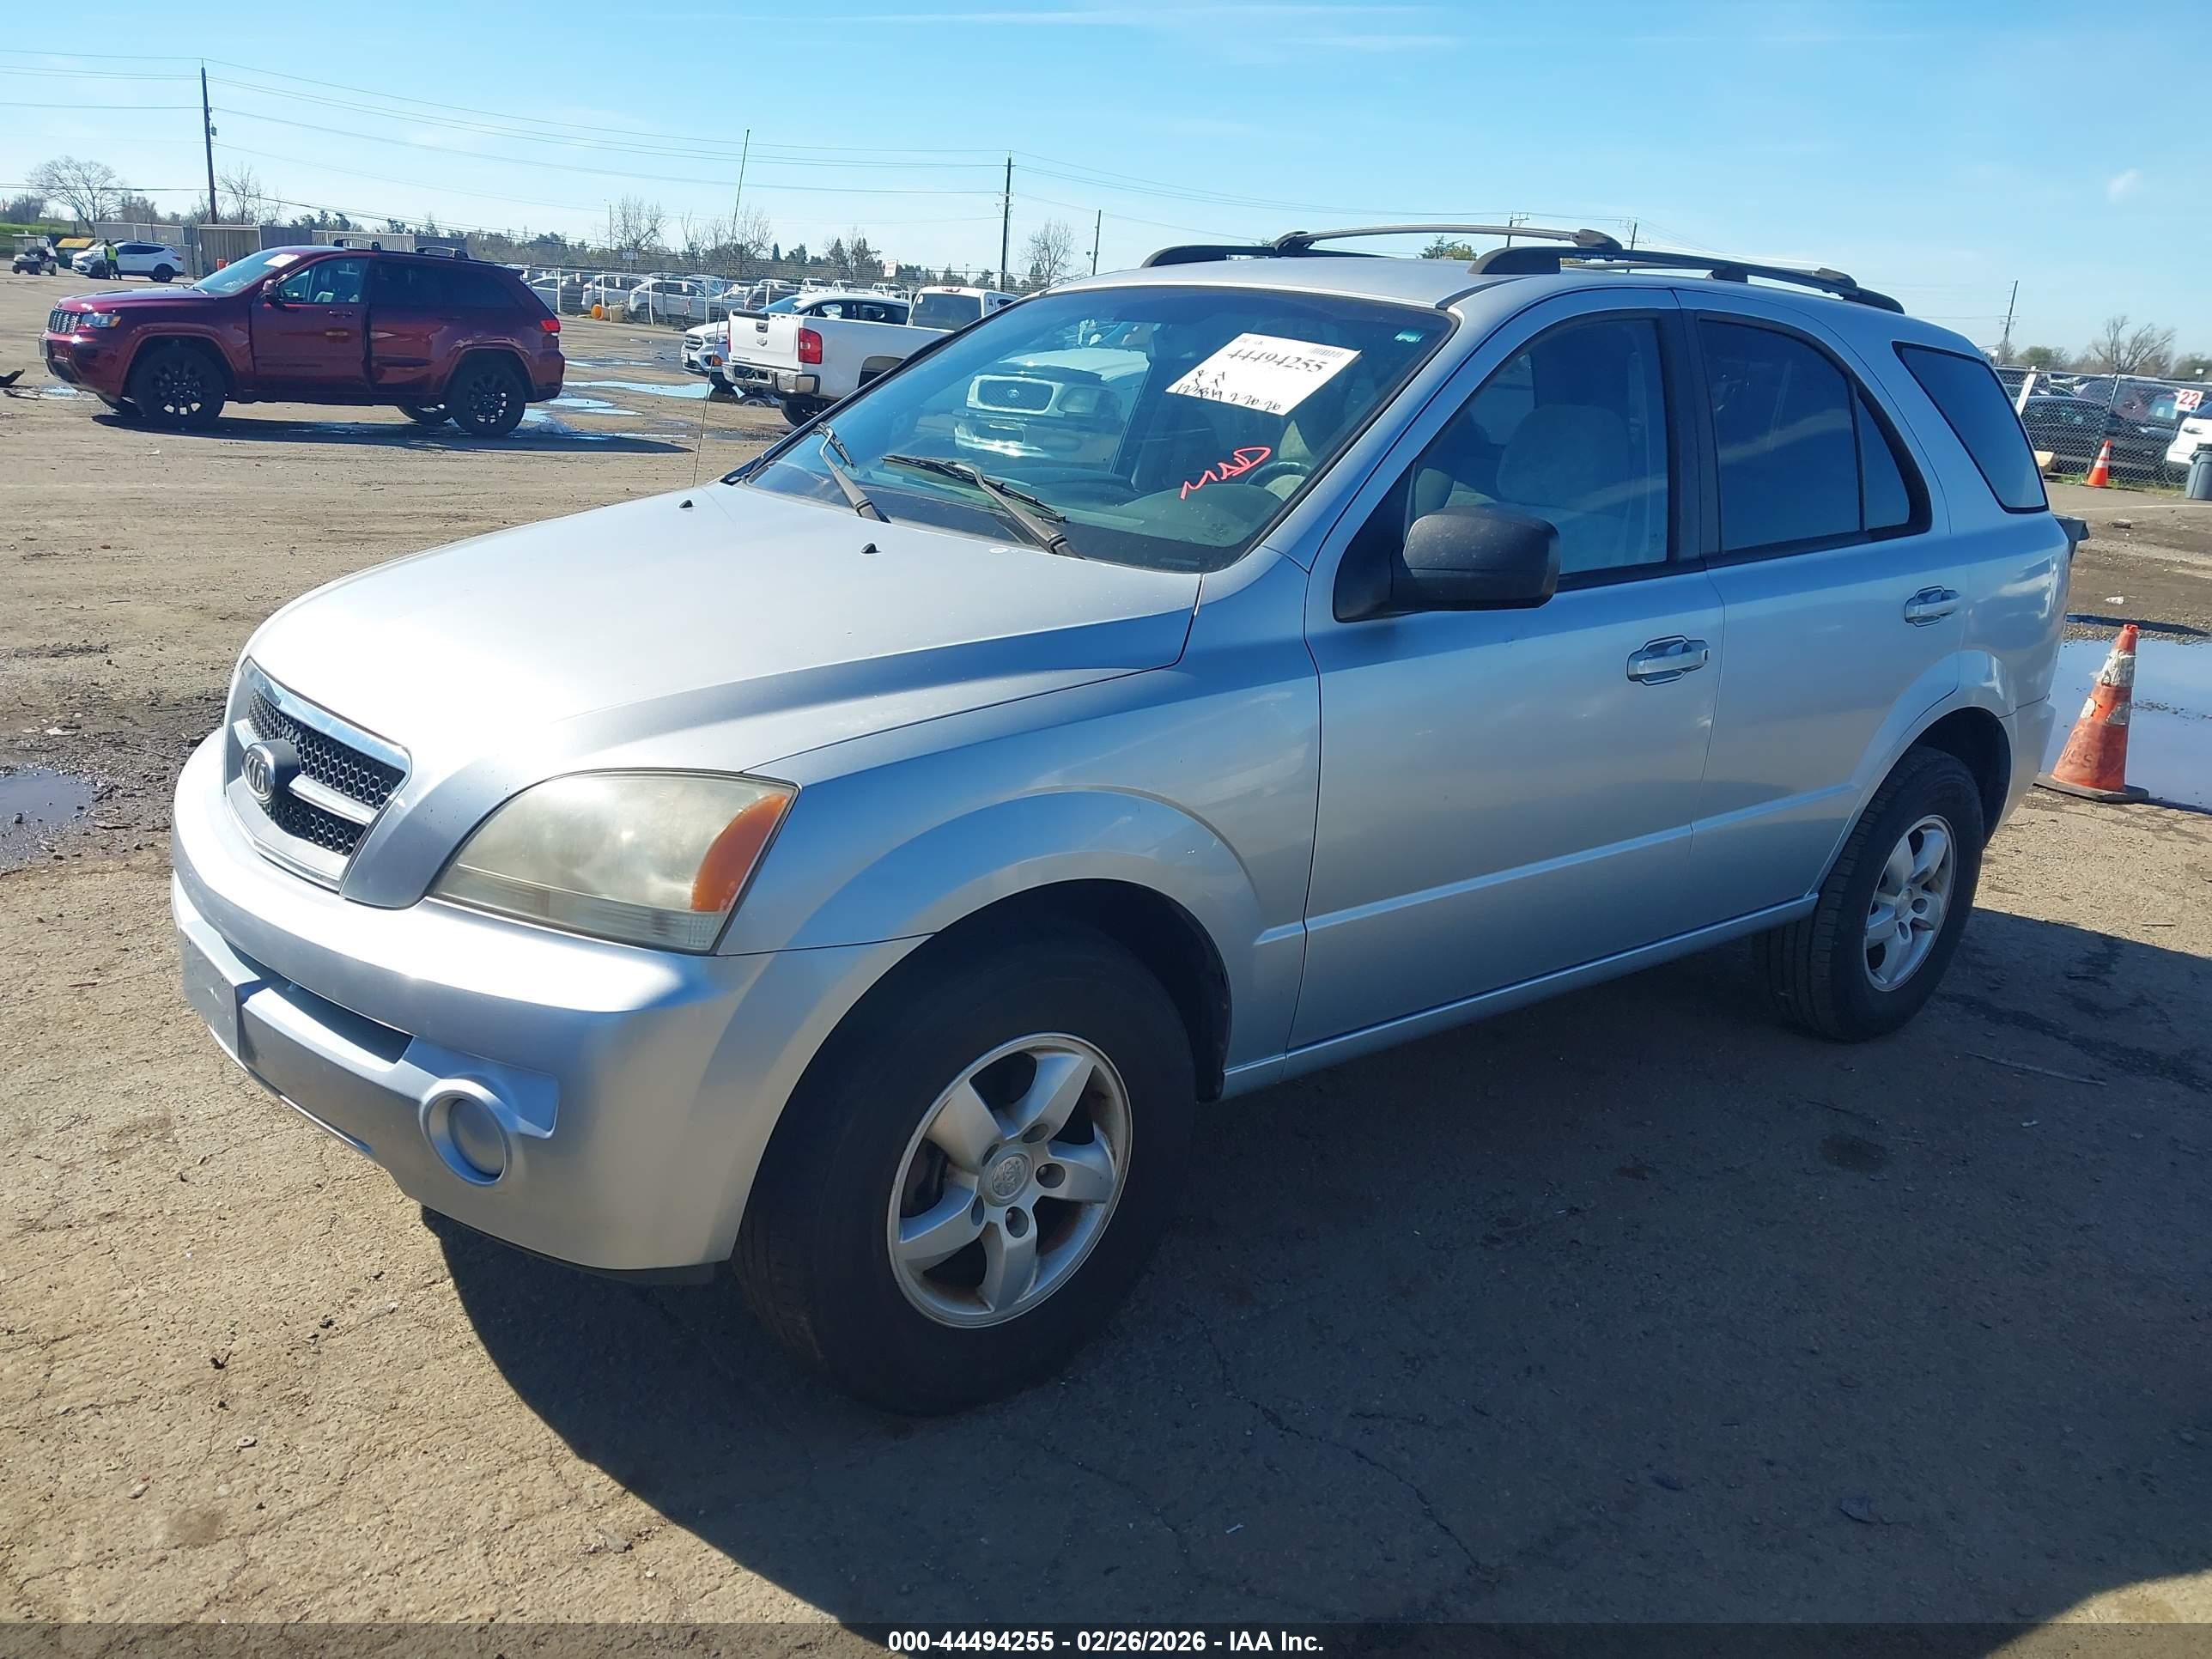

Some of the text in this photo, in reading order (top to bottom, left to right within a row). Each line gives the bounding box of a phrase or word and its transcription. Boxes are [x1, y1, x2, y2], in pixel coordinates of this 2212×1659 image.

[1227, 349, 1328, 373] 44494255
[2179, 391, 2199, 406] 22
[1181, 447, 1272, 500] MAD
[245, 752, 266, 795] KIA
